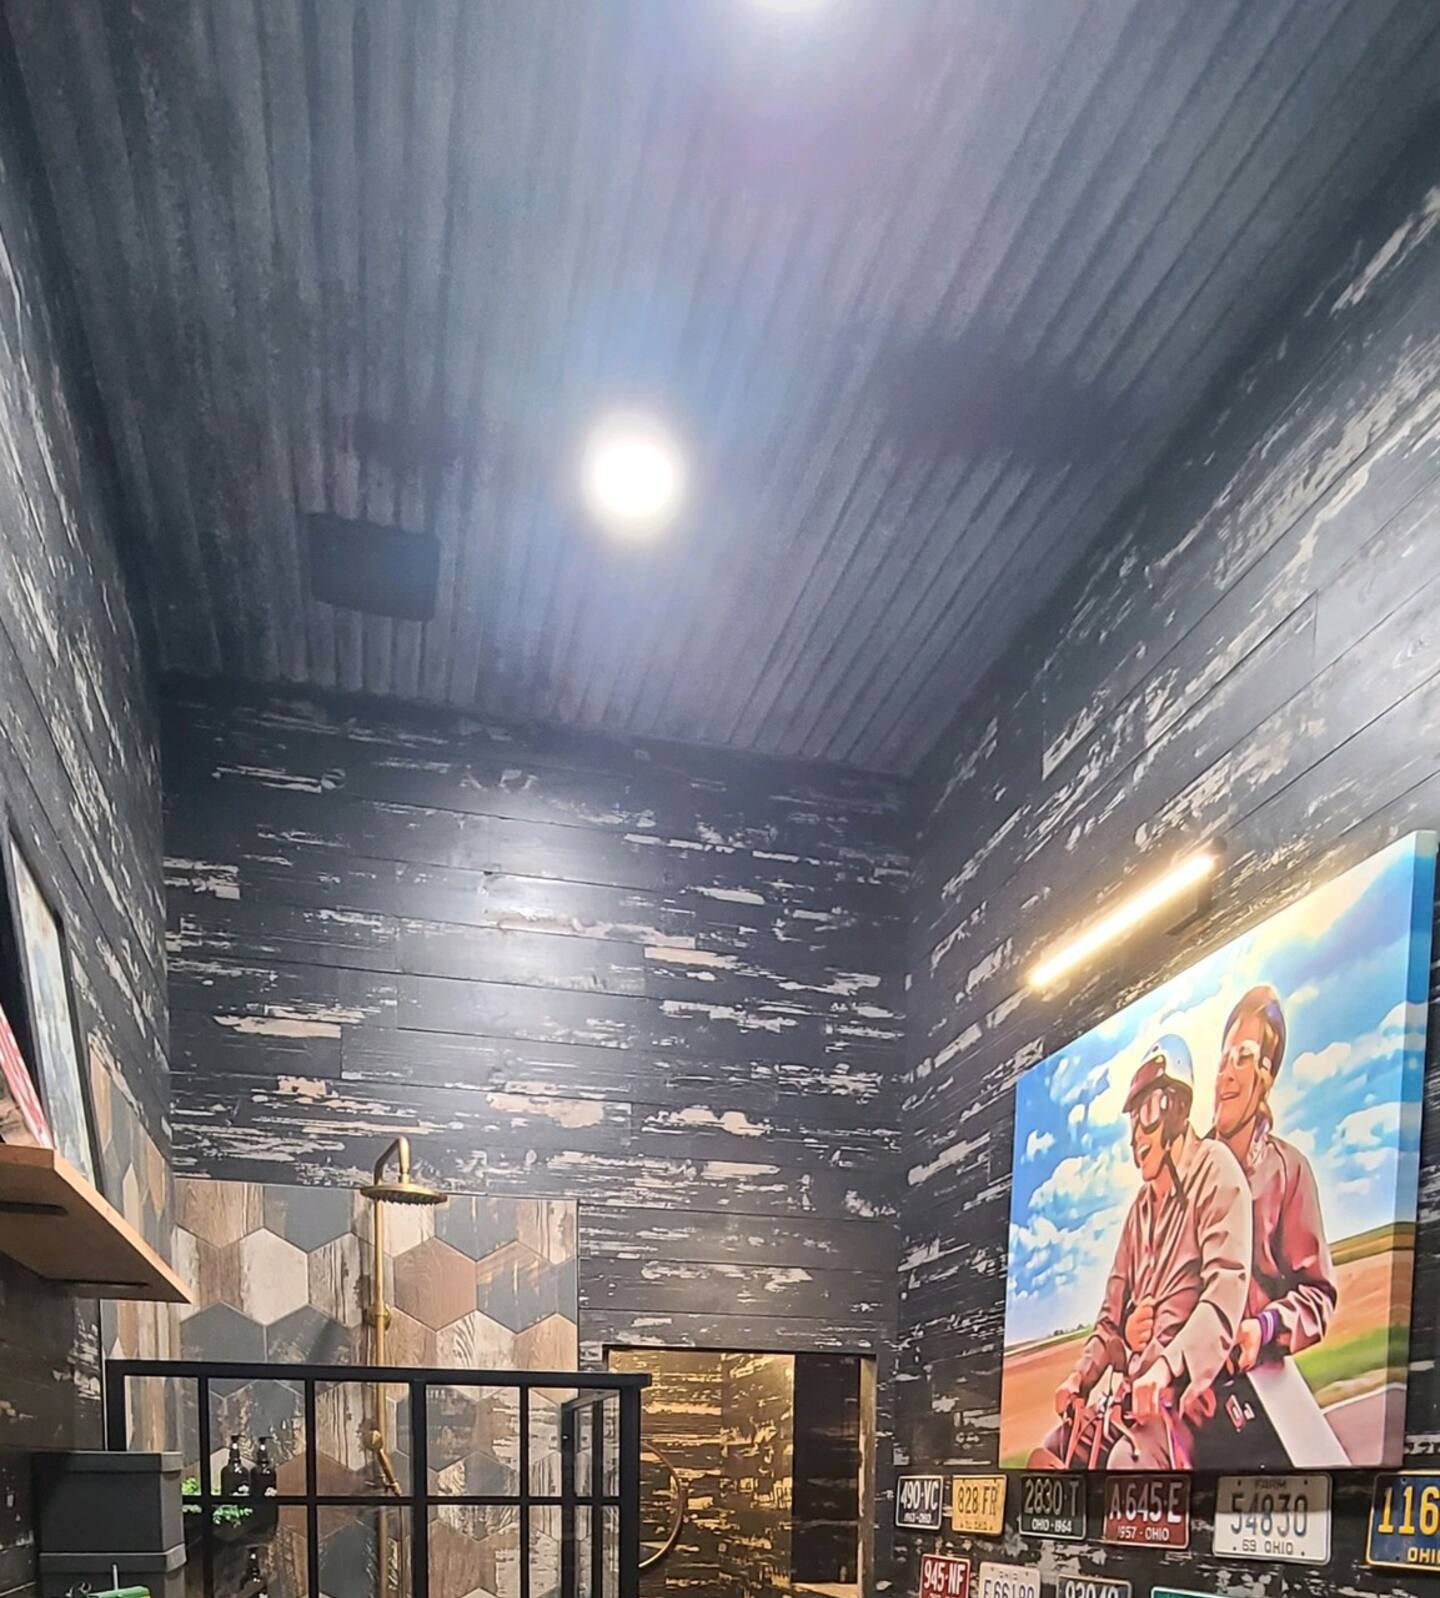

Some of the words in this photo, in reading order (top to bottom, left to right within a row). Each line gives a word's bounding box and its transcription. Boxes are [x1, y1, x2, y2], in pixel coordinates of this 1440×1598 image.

[958, 1486, 978, 1514] 828
[1230, 1492, 1308, 1537] 54830
[1145, 1527, 1170, 1541] OHIO
[1264, 1538, 1294, 1555] OHIO
